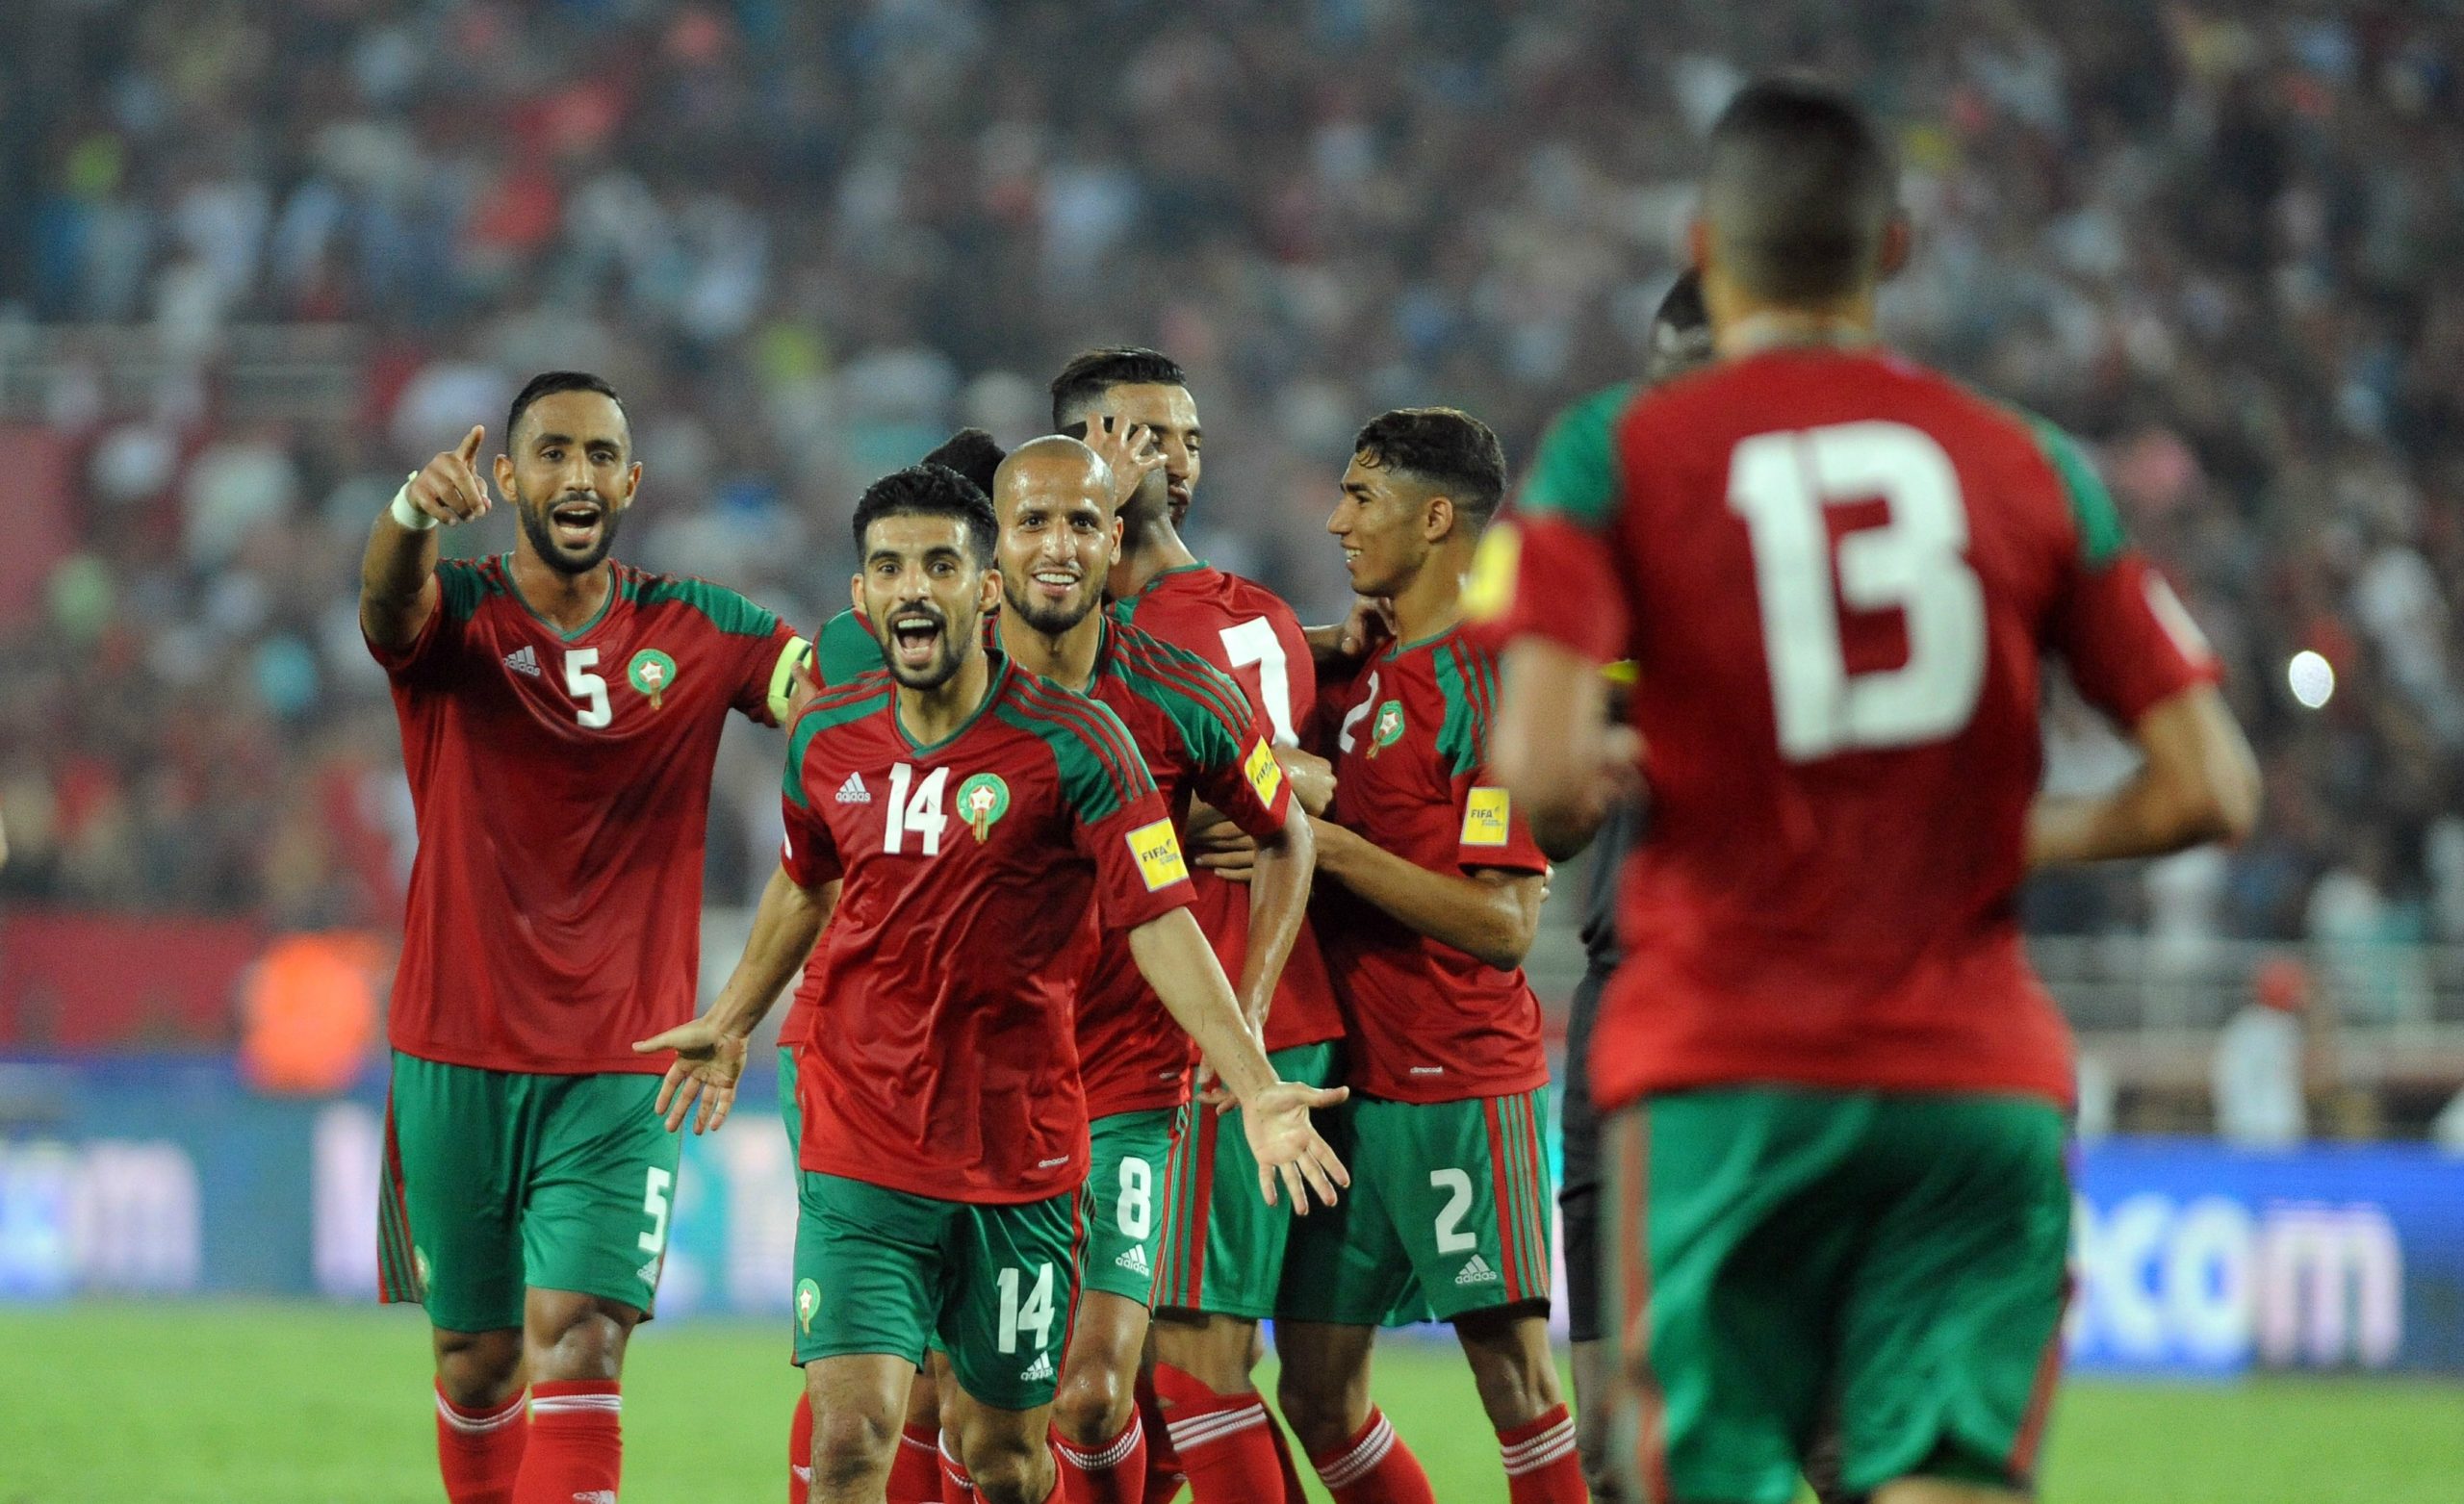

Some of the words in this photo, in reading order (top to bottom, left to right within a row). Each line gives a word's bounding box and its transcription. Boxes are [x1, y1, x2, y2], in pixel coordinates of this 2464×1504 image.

[1727, 420, 1987, 760] 13
[502, 657, 541, 676] adidas
[565, 647, 612, 728] 5
[1219, 615, 1299, 749] 7
[1339, 670, 1379, 753] 2
[835, 791, 871, 803] adidas
[884, 761, 949, 856] 14
[1471, 808, 1493, 818] FIFA
[1142, 846, 1168, 862] FIFA
[638, 1165, 671, 1253] 5
[1117, 1156, 1152, 1240] 8
[1430, 1167, 1476, 1254] 2
[1116, 1256, 1150, 1277] adidas
[1454, 1270, 1498, 1285] adidas
[997, 1262, 1056, 1354] 14
[1020, 1366, 1054, 1381] adidas
